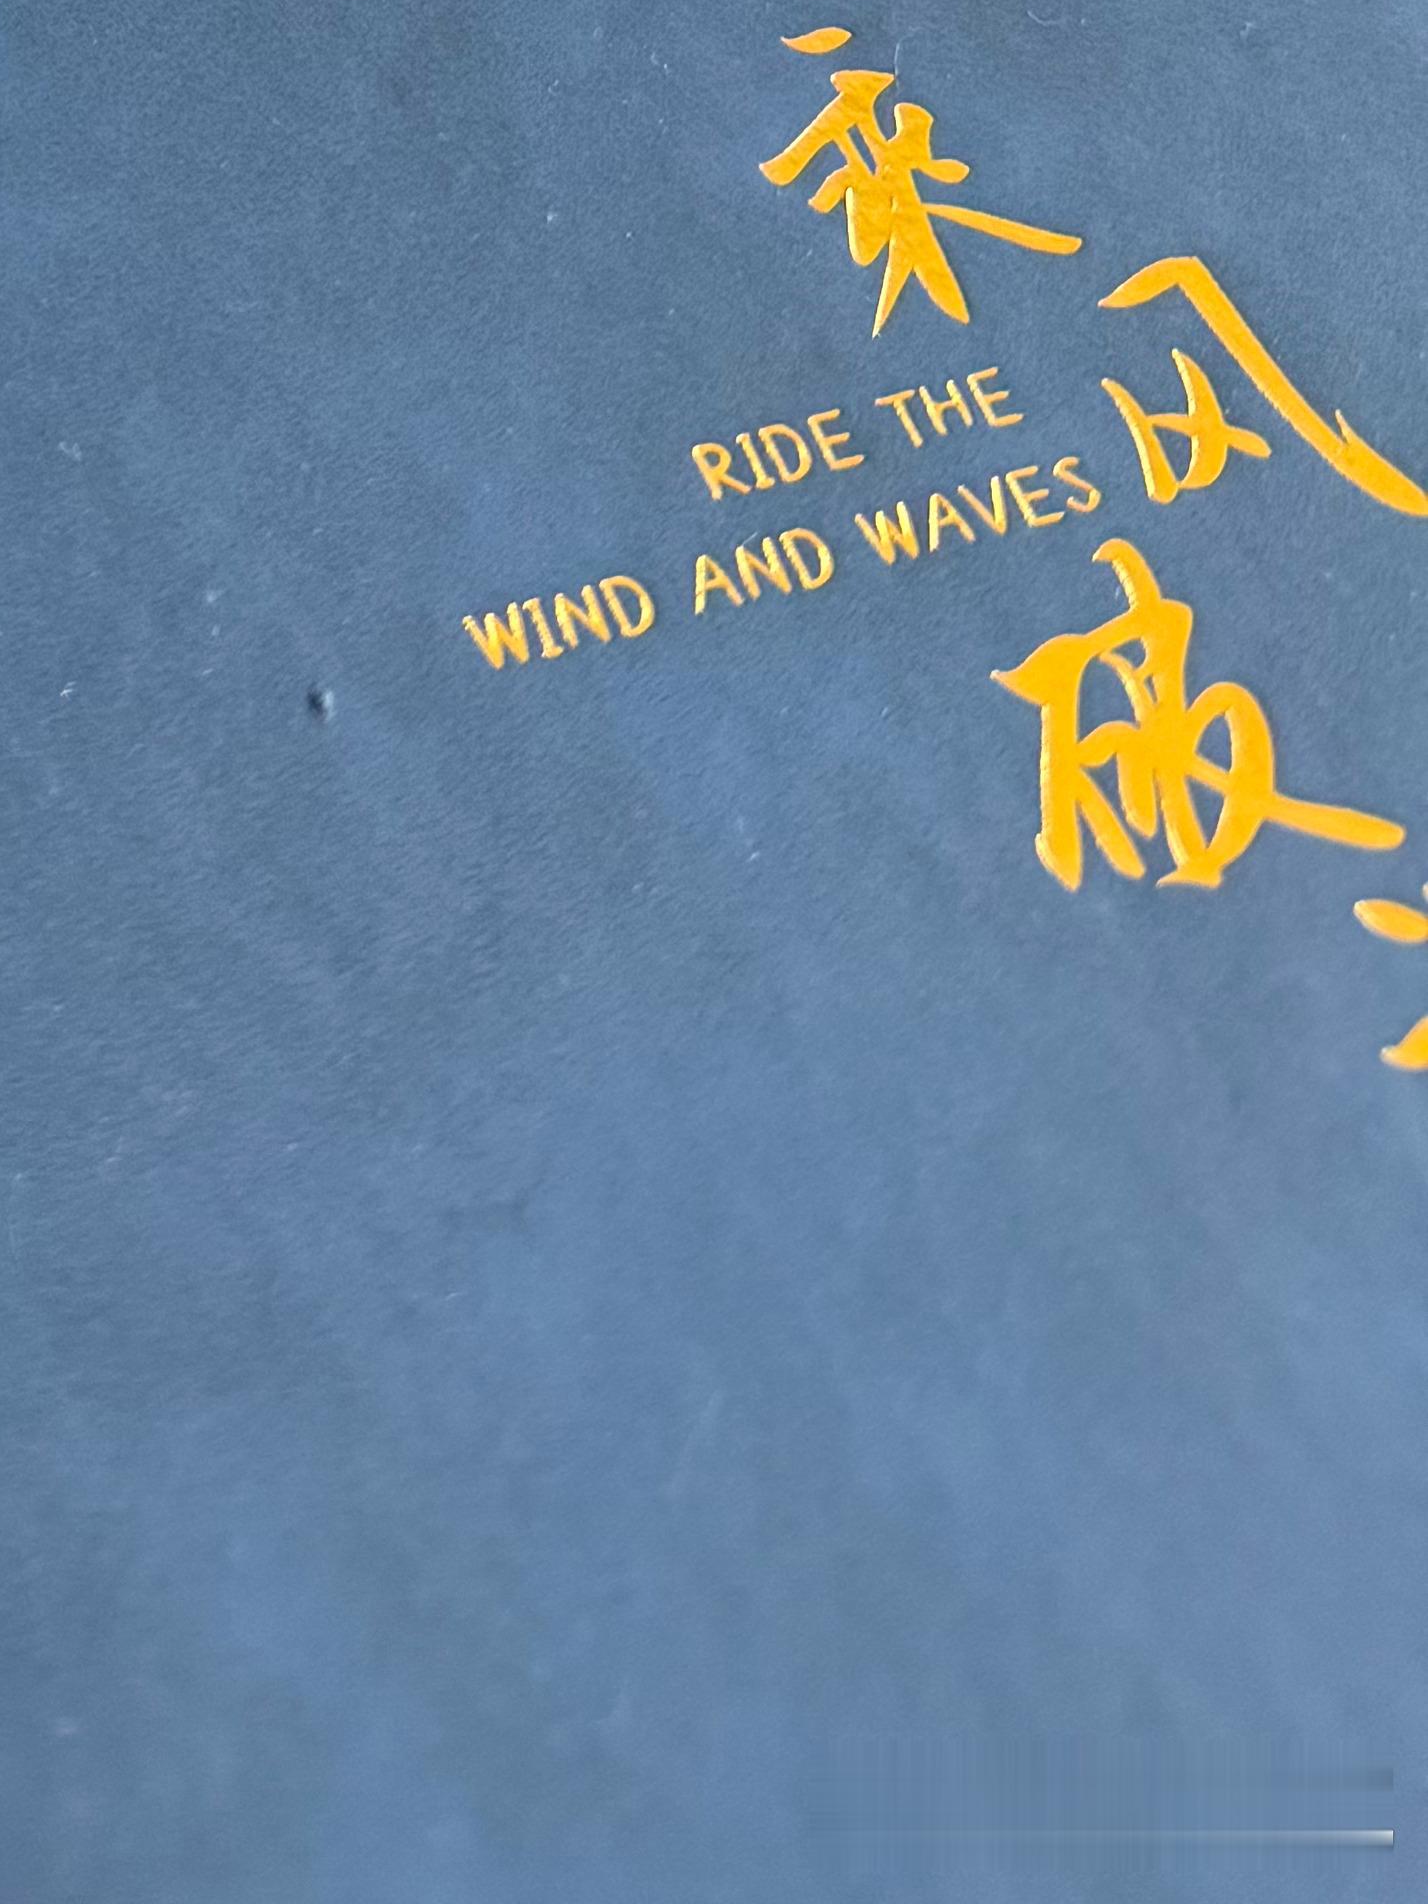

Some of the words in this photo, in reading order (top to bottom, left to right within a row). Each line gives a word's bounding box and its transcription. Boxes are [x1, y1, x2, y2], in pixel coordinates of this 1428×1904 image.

[691, 408, 865, 501] RIDE
[874, 365, 1024, 448] THE
[462, 574, 656, 670] WIND
[693, 527, 835, 615] AND
[854, 455, 1102, 566] WAVES
